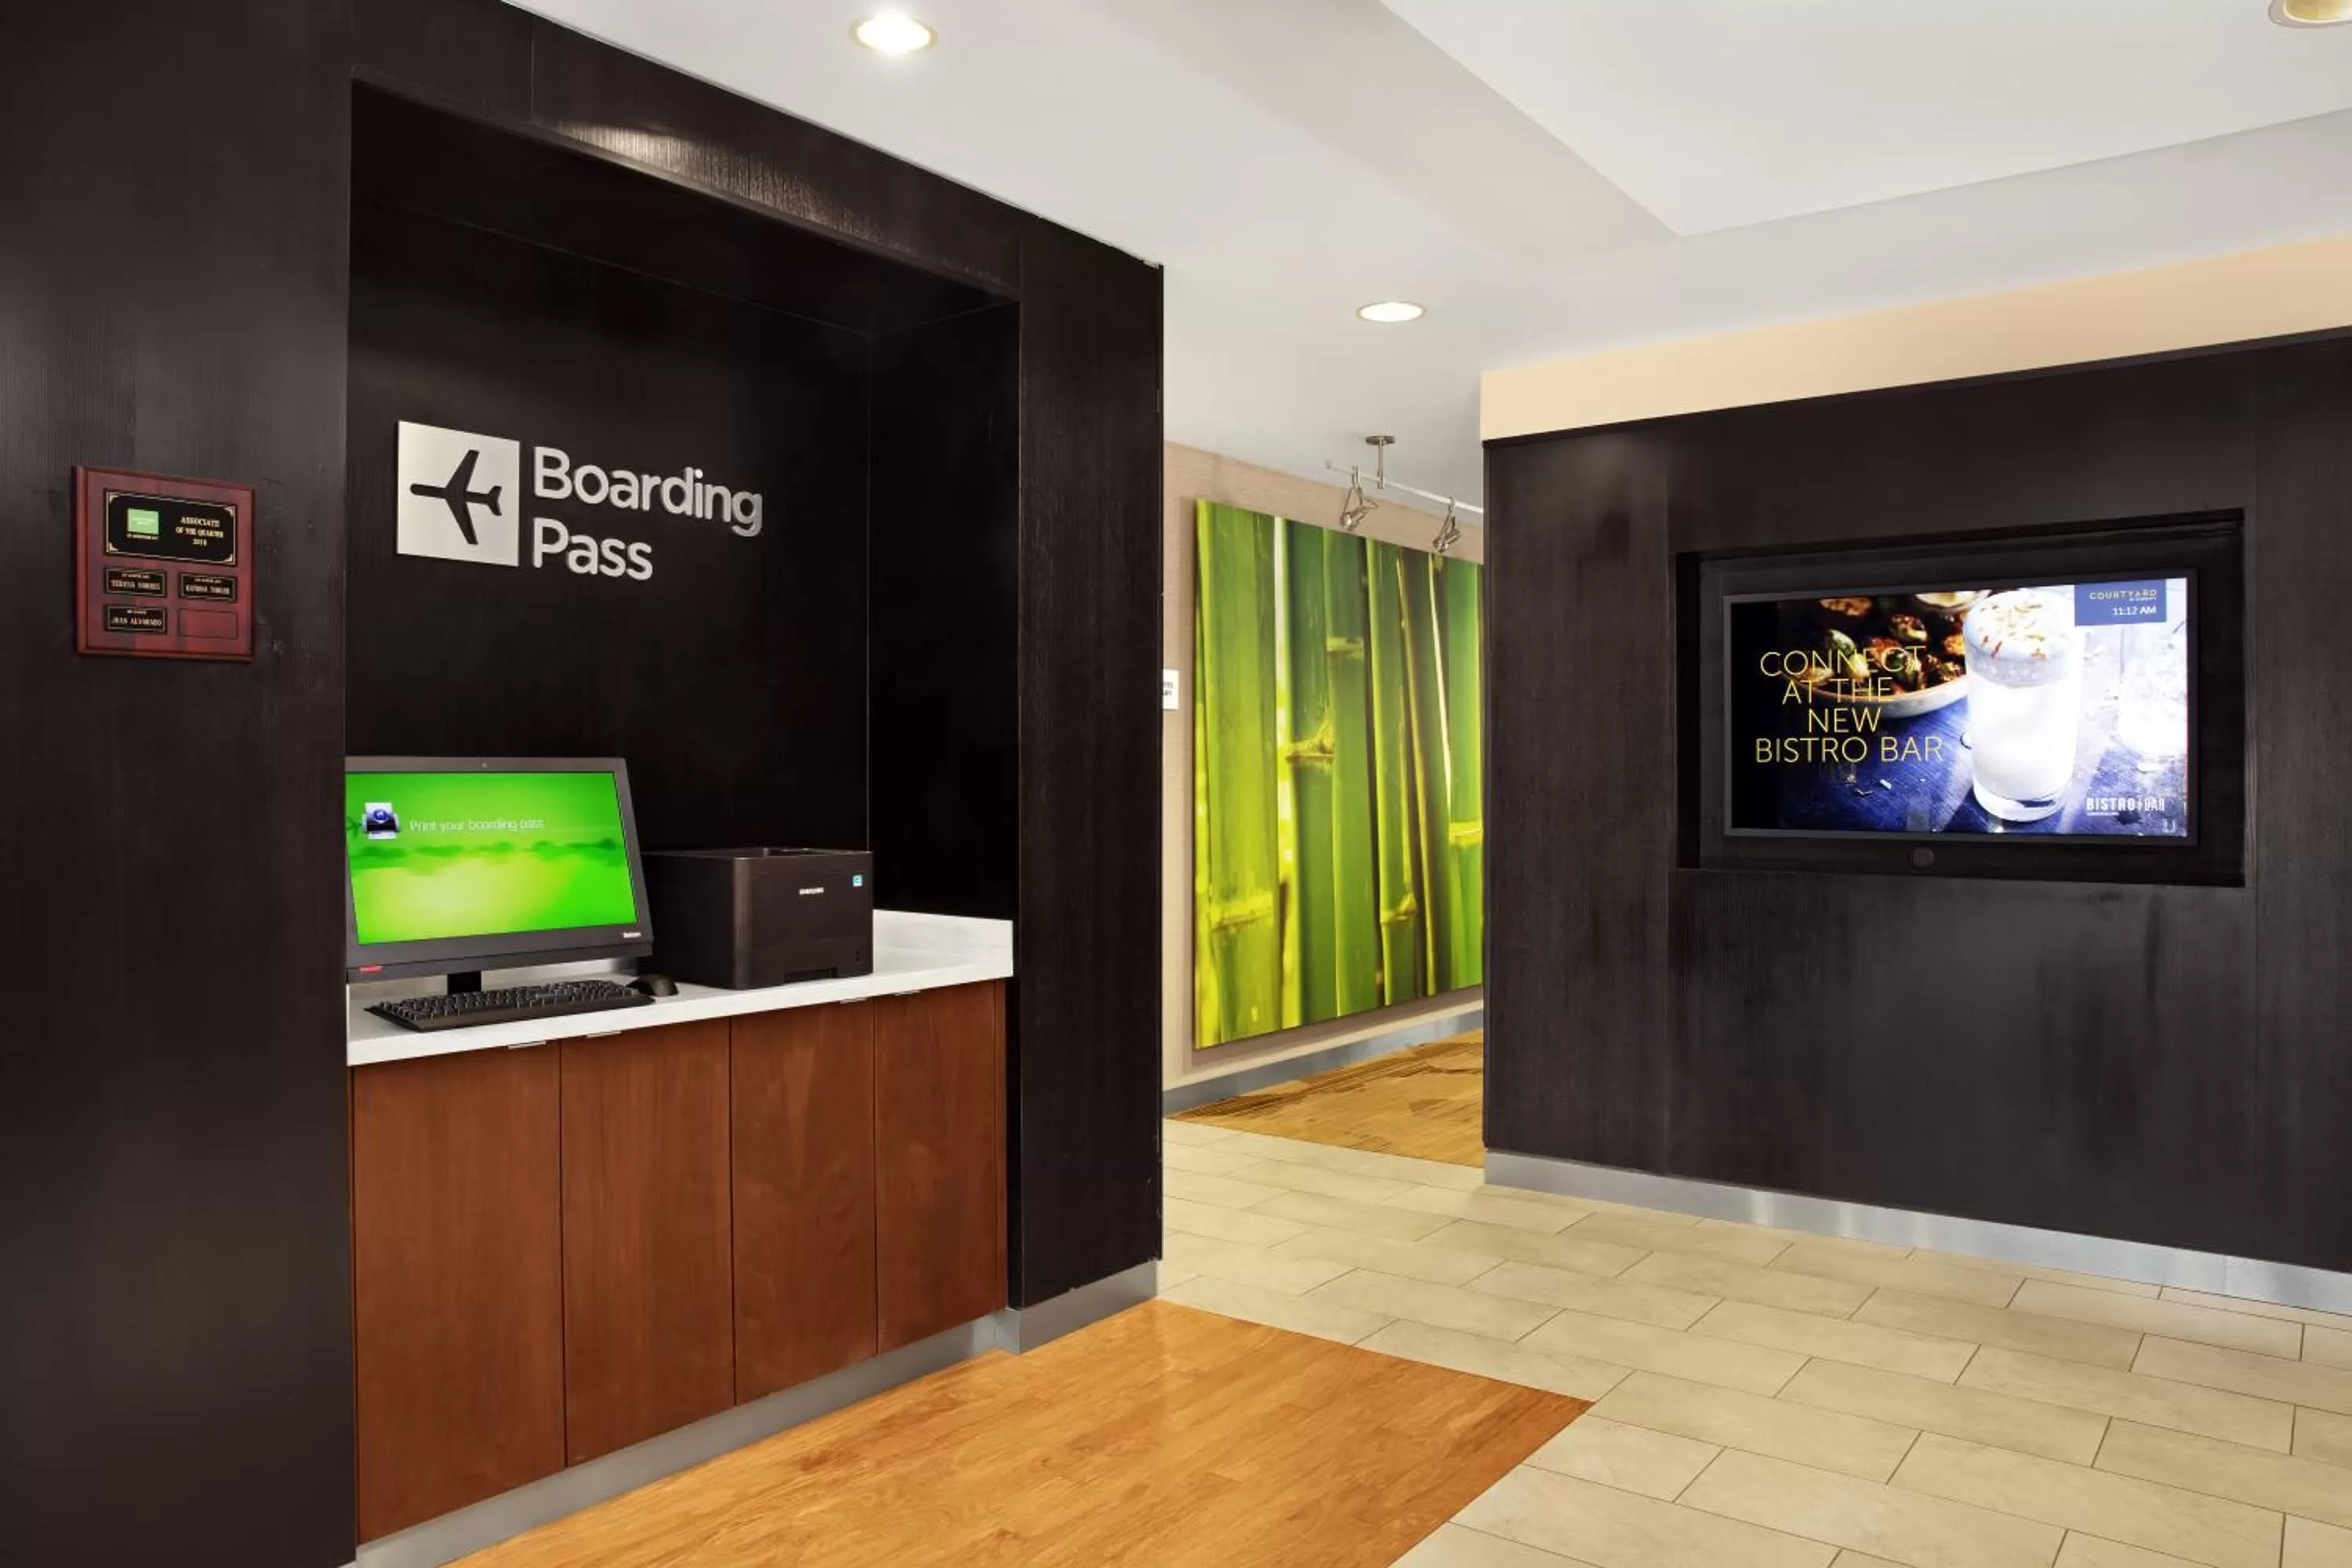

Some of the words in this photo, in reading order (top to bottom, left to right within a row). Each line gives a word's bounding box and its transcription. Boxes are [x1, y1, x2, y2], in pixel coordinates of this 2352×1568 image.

[533, 445, 764, 537] Boarding
[532, 517, 654, 580] Pass
[2089, 589, 2158, 601] COURTYARD
[2140, 605, 2157, 615] AM
[1760, 645, 1926, 677] CONNECT
[1782, 678, 1819, 705] AT
[1827, 677, 1894, 703] THE
[1808, 707, 1882, 734] NEW
[1755, 735, 1867, 764] BISTRO
[1881, 735, 1944, 763] BAR
[2086, 797, 2136, 811] BISTRO
[409, 818, 437, 831] Print
[438, 821, 466, 835] your
[468, 817, 517, 833] boarding
